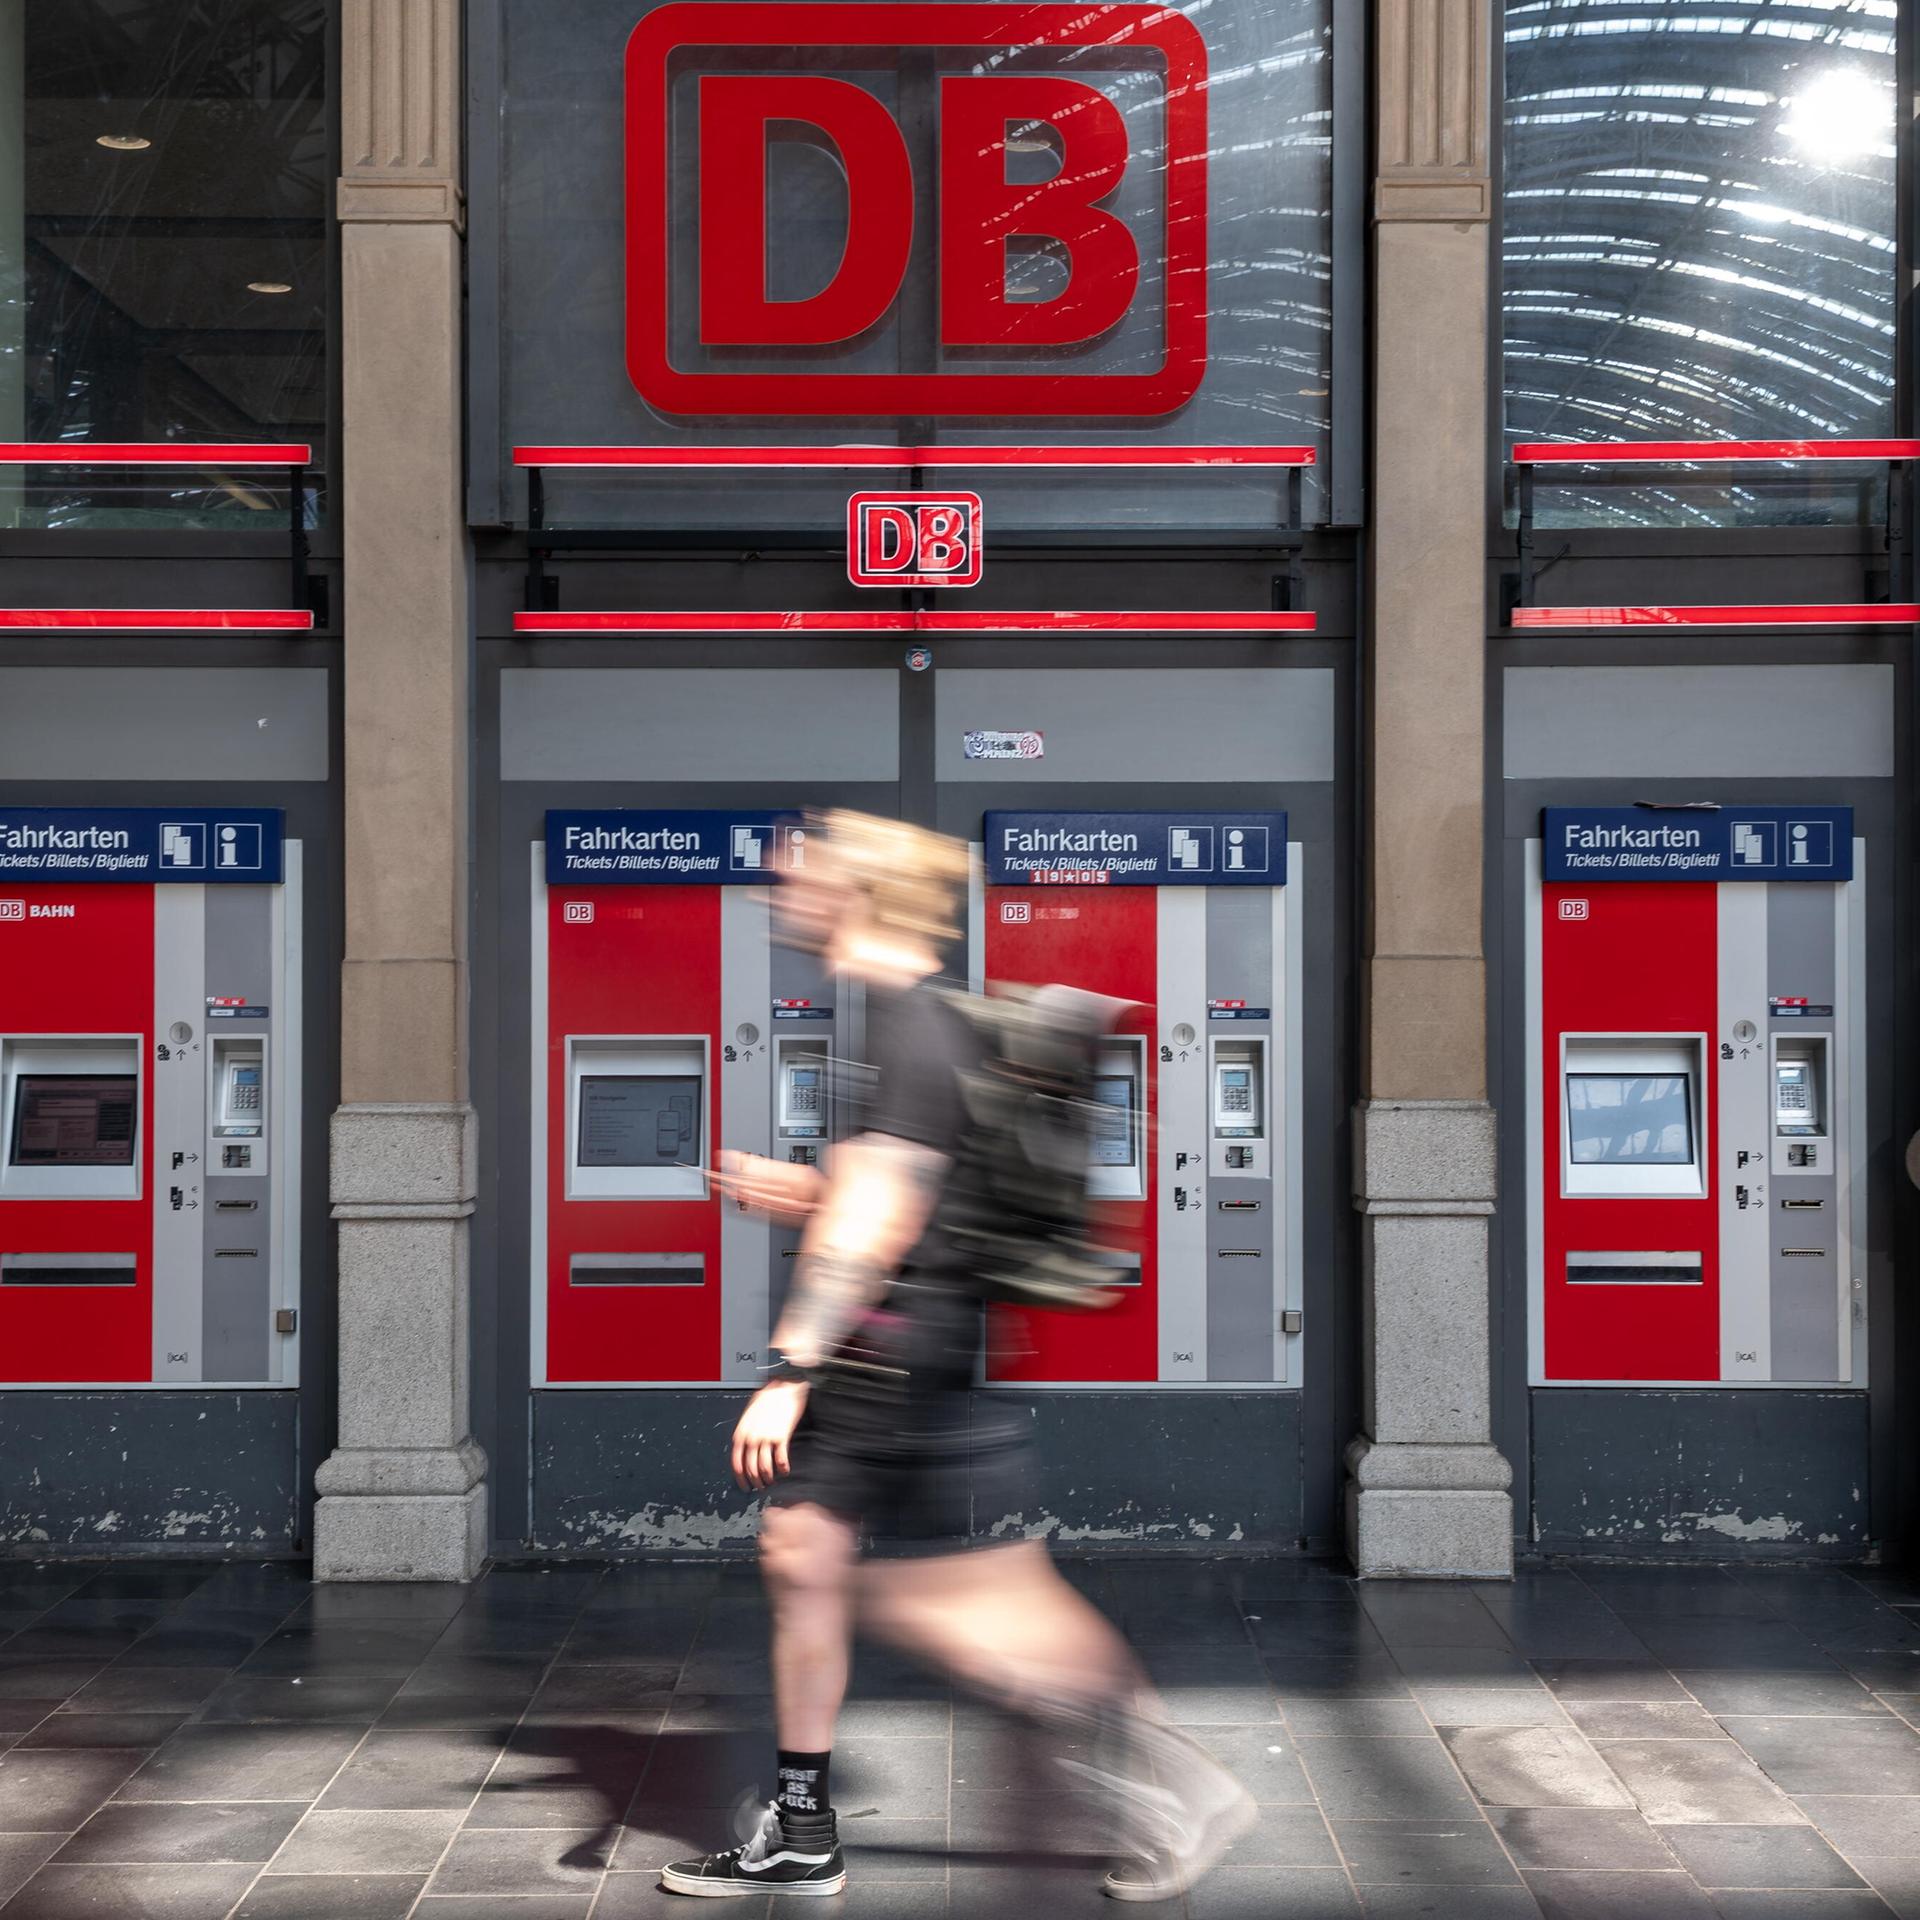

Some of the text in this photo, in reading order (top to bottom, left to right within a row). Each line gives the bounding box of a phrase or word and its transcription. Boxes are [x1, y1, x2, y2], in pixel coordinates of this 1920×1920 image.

[699, 75, 1140, 346] DB
[865, 506, 967, 573] DB
[565, 826, 700, 850] Fahrkarten
[1004, 828, 1138, 852] Fahrkarten
[1565, 825, 1700, 848] Fahrkarten
[565, 855, 721, 872] Tickets/Billets/Biglietti
[1004, 857, 1158, 874] Tickets/Billets/Biglietti
[1565, 853, 1721, 870] Tickets/Billets/Biglietti
[29, 904, 76, 918] BAHN
